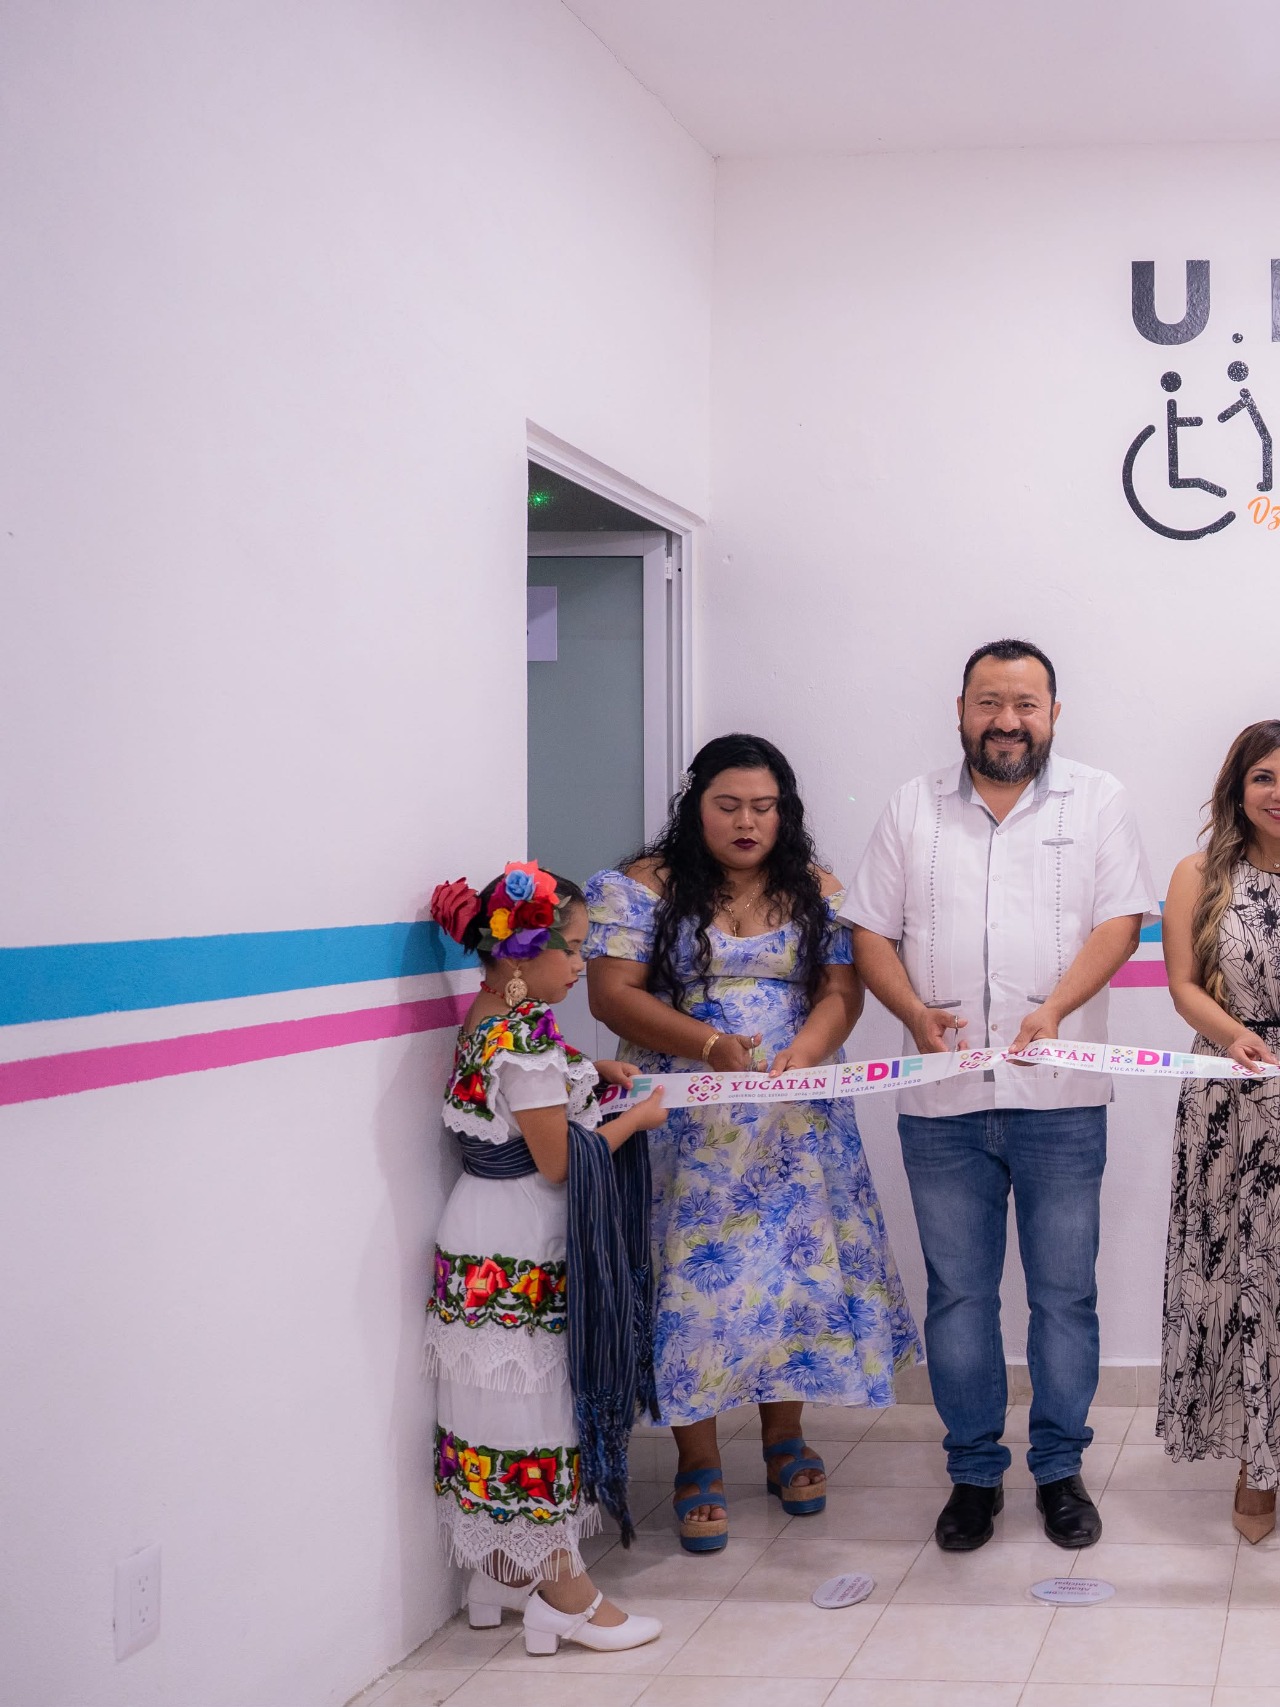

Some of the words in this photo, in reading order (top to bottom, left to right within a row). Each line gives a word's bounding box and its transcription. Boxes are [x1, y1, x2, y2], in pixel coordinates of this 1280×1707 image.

[1136, 1049, 1195, 1068] DIF
[867, 1057, 923, 1082] DIF
[599, 1077, 653, 1107] DIF
[730, 1077, 828, 1092] YUCATÁN
[840, 1085, 875, 1094] YUCATÁN
[883, 1078, 922, 1089] 2024-2030
[611, 1102, 636, 1111] 2024-2
